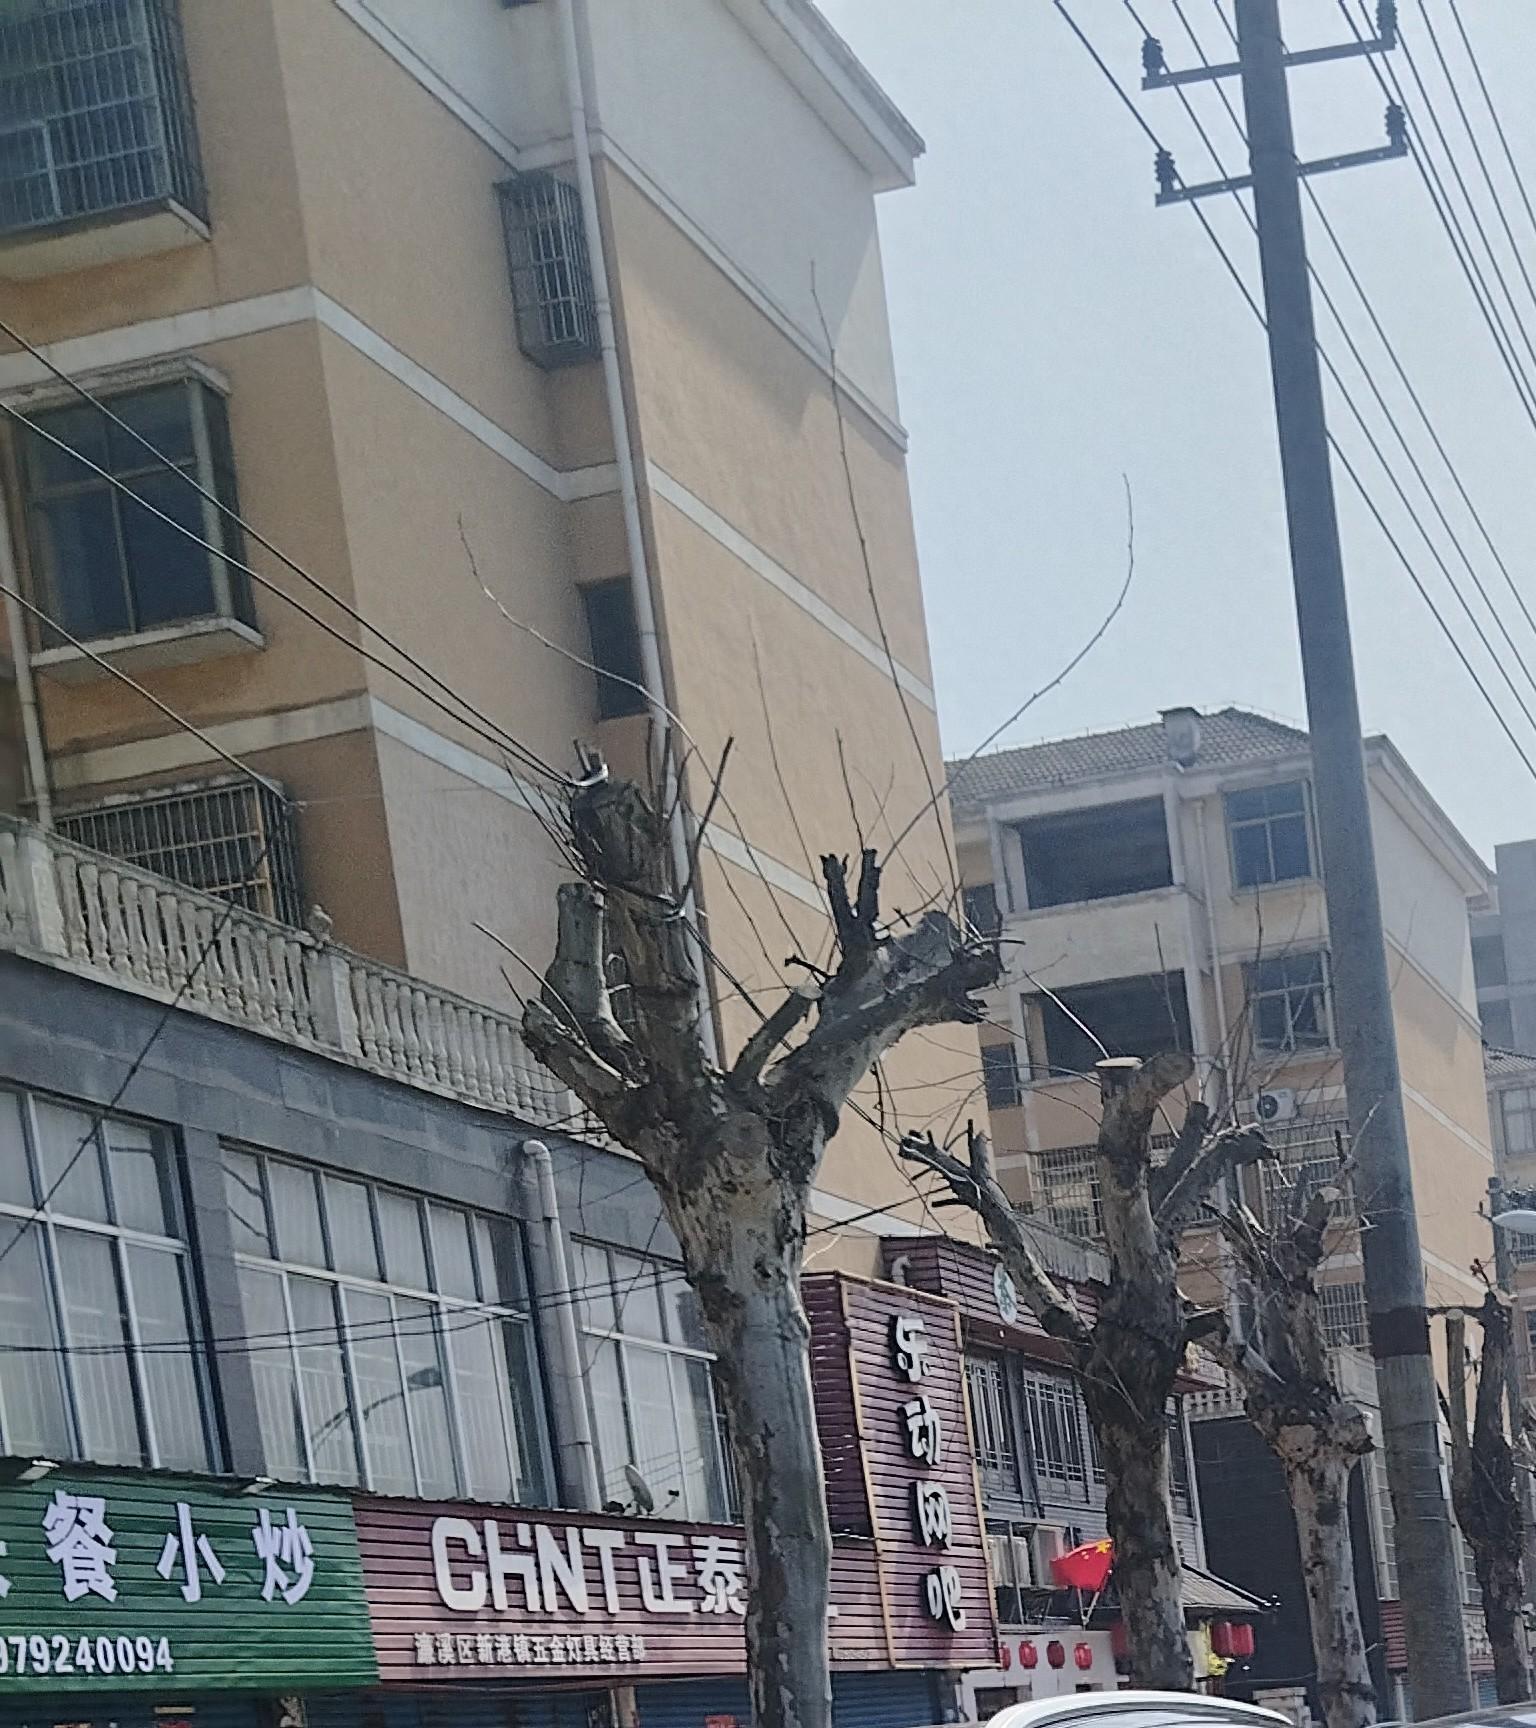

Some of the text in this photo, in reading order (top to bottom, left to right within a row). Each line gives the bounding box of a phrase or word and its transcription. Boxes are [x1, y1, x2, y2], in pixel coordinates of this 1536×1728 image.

[895, 1316, 967, 1633] 乐动网吧
[0, 1489, 315, 1606] 餐小炒
[634, 1531, 747, 1616] 正泰
